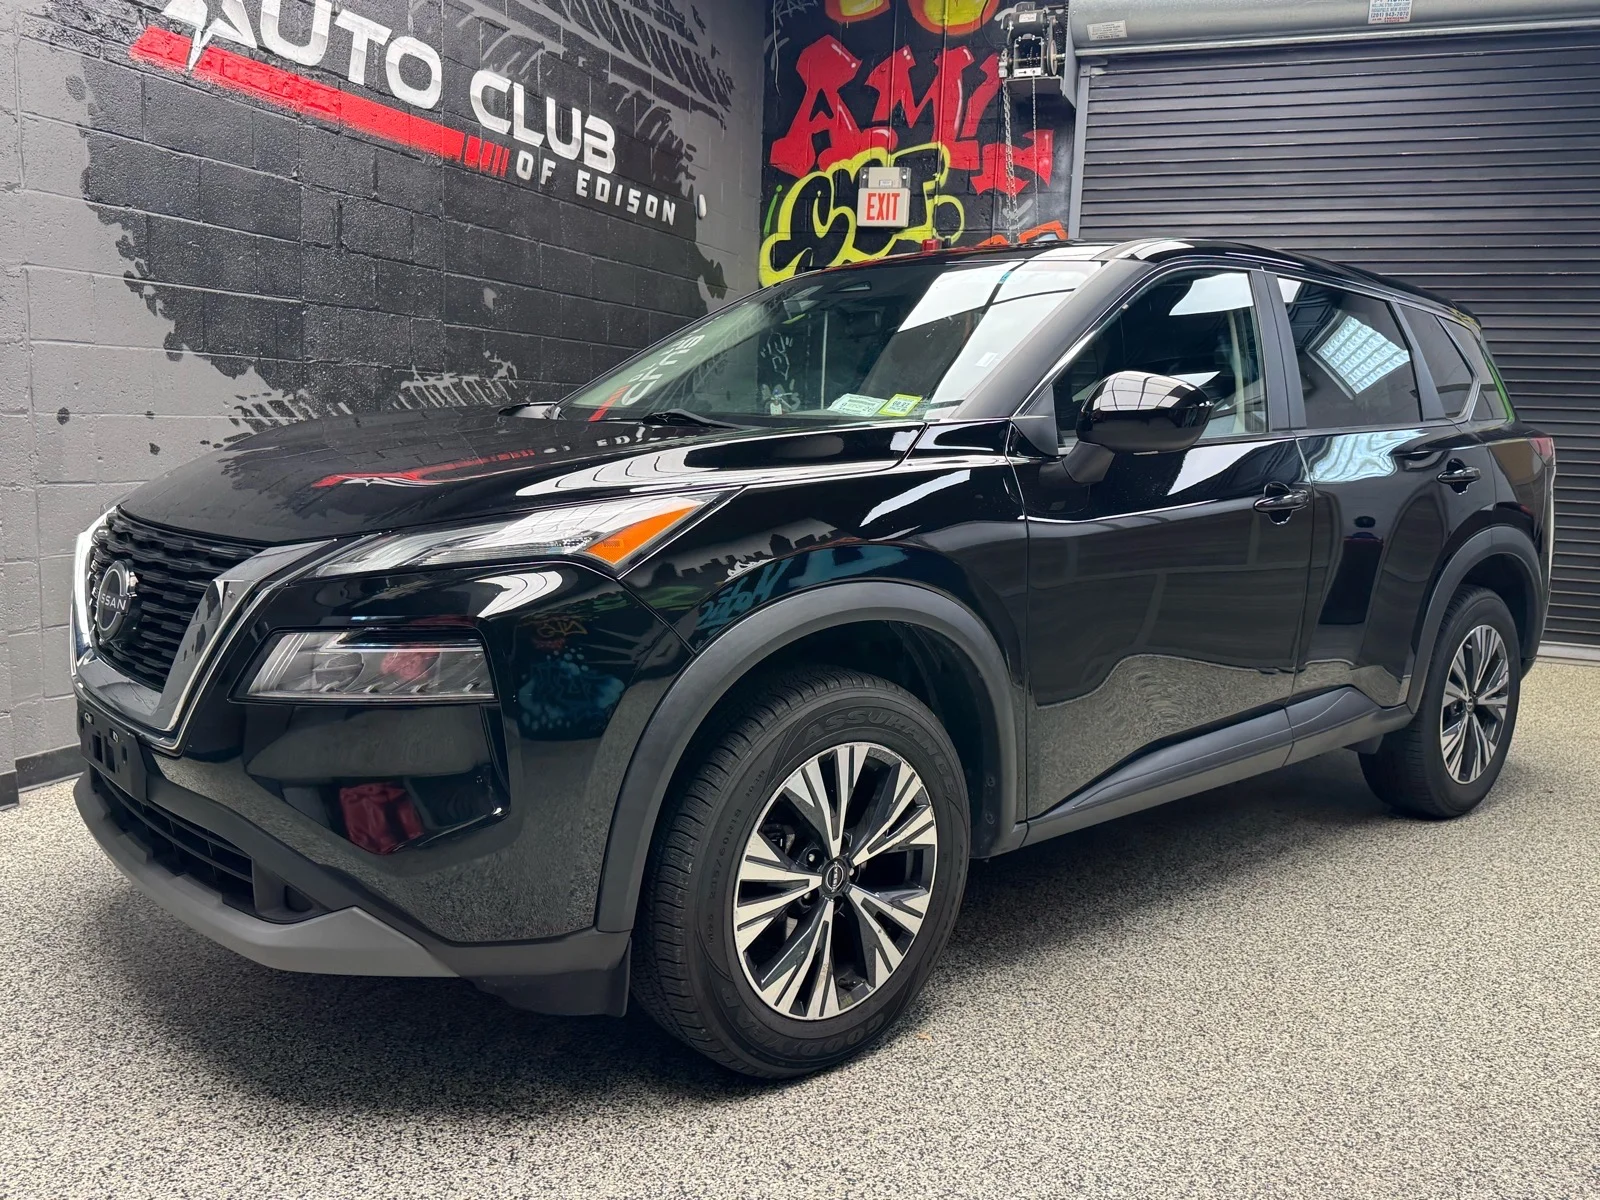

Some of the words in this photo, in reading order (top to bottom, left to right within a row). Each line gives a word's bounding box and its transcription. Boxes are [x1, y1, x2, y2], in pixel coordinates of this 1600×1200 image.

[162, 0, 442, 110] AUTO
[470, 70, 616, 174] CLUB
[516, 149, 556, 185] OF
[576, 168, 676, 226] EDISON
[866, 192, 901, 221] EXIT
[100, 593, 127, 611] SSAN
[803, 710, 955, 795] ASSURANCE
[720, 986, 885, 1057] GOODYEAR
